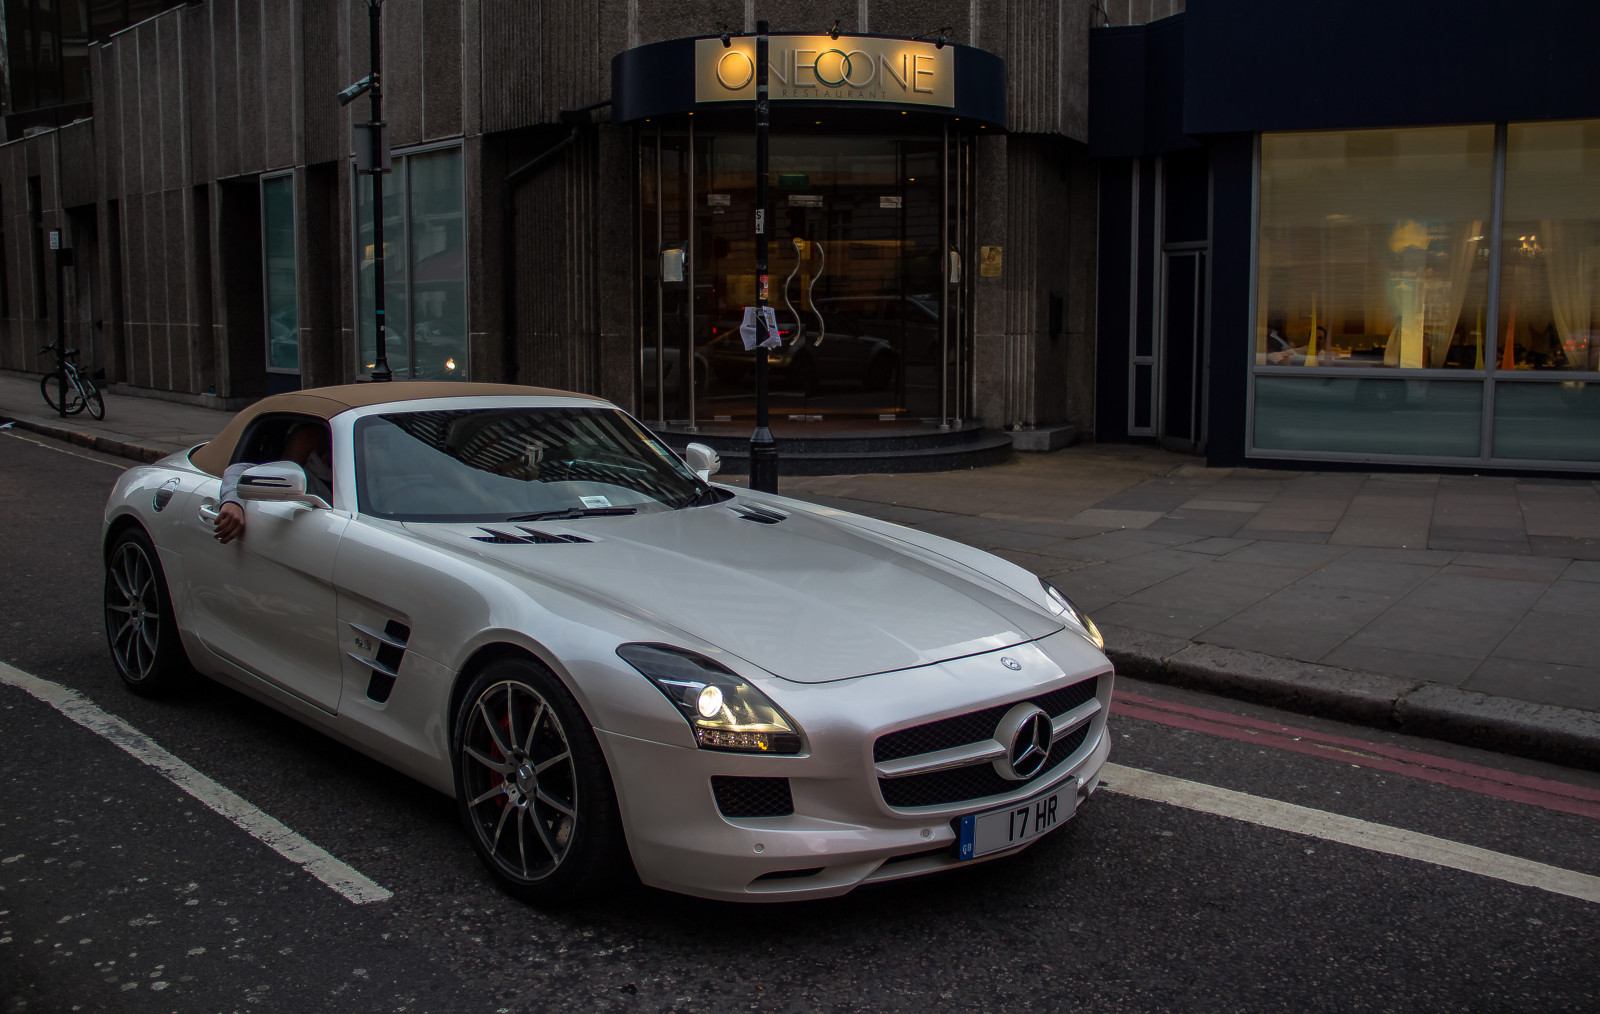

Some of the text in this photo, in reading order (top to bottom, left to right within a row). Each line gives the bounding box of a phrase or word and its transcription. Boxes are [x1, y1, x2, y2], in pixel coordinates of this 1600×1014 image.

[782, 89, 887, 99] RESTAURANT
[1009, 795, 1058, 841] 17 HR
[962, 842, 972, 855] GB
